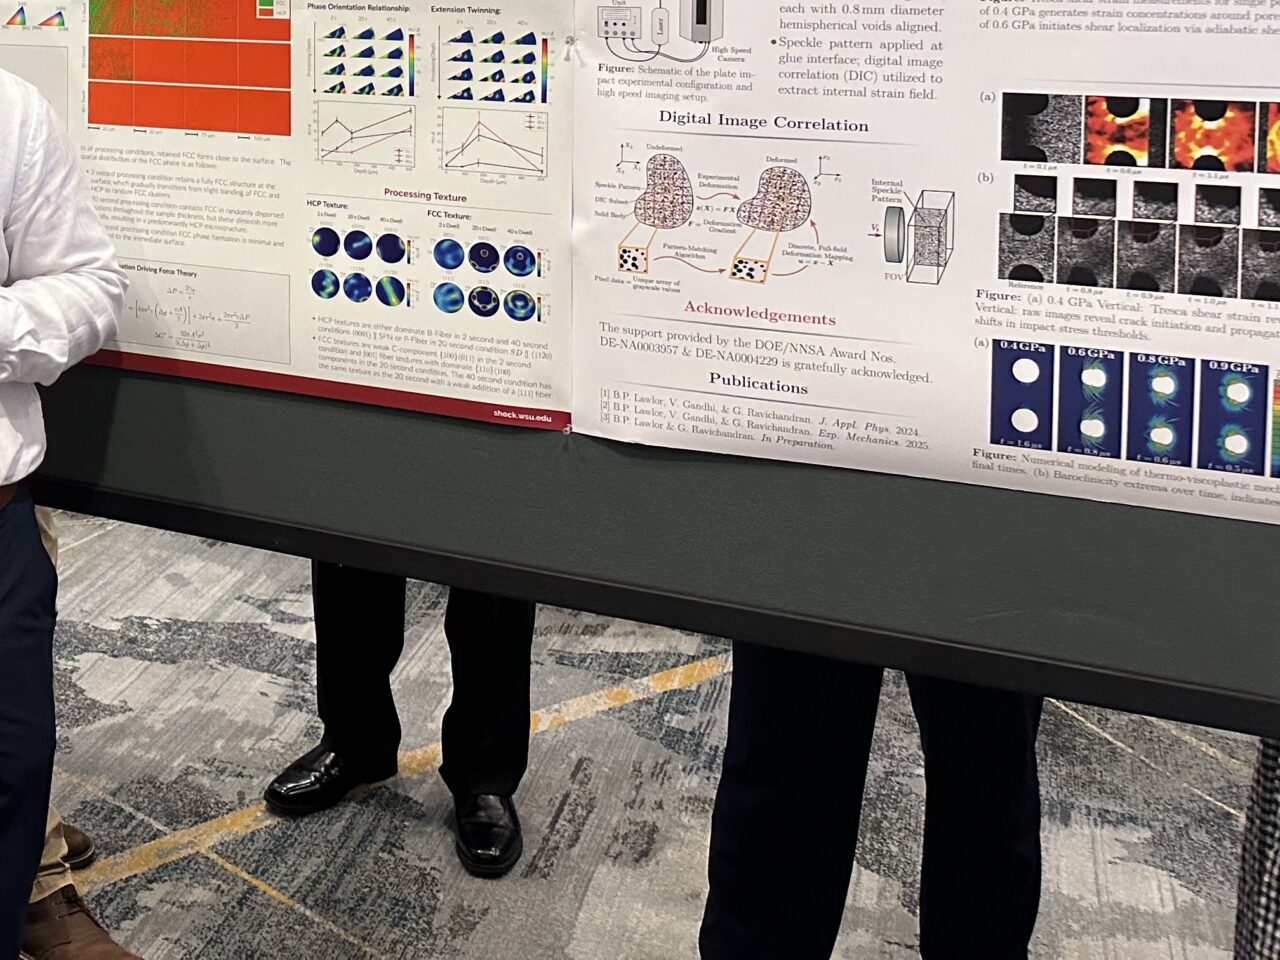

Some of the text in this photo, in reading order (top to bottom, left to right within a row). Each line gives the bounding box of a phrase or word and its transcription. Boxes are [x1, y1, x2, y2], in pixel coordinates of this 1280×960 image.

[306, 2, 327, 10] Phase
[366, 3, 411, 12] Relationship:
[430, 5, 502, 15] Extension Twinning:
[597, 63, 635, 74] Figure:
[659, 110, 869, 131] Digital Image Correlation
[383, 187, 467, 202] Processing Texture
[322, 200, 349, 209] Texture:
[426, 209, 472, 220] FCC Texture:
[975, 288, 1021, 301] Figure:
[684, 301, 836, 325] Acknowledgements
[598, 321, 896, 363] The support provided by the DOE/NNSA Award Nos.
[709, 372, 808, 394] Publications
[493, 410, 552, 422] shock.wsu.edu
[971, 447, 1017, 461] Figure:
